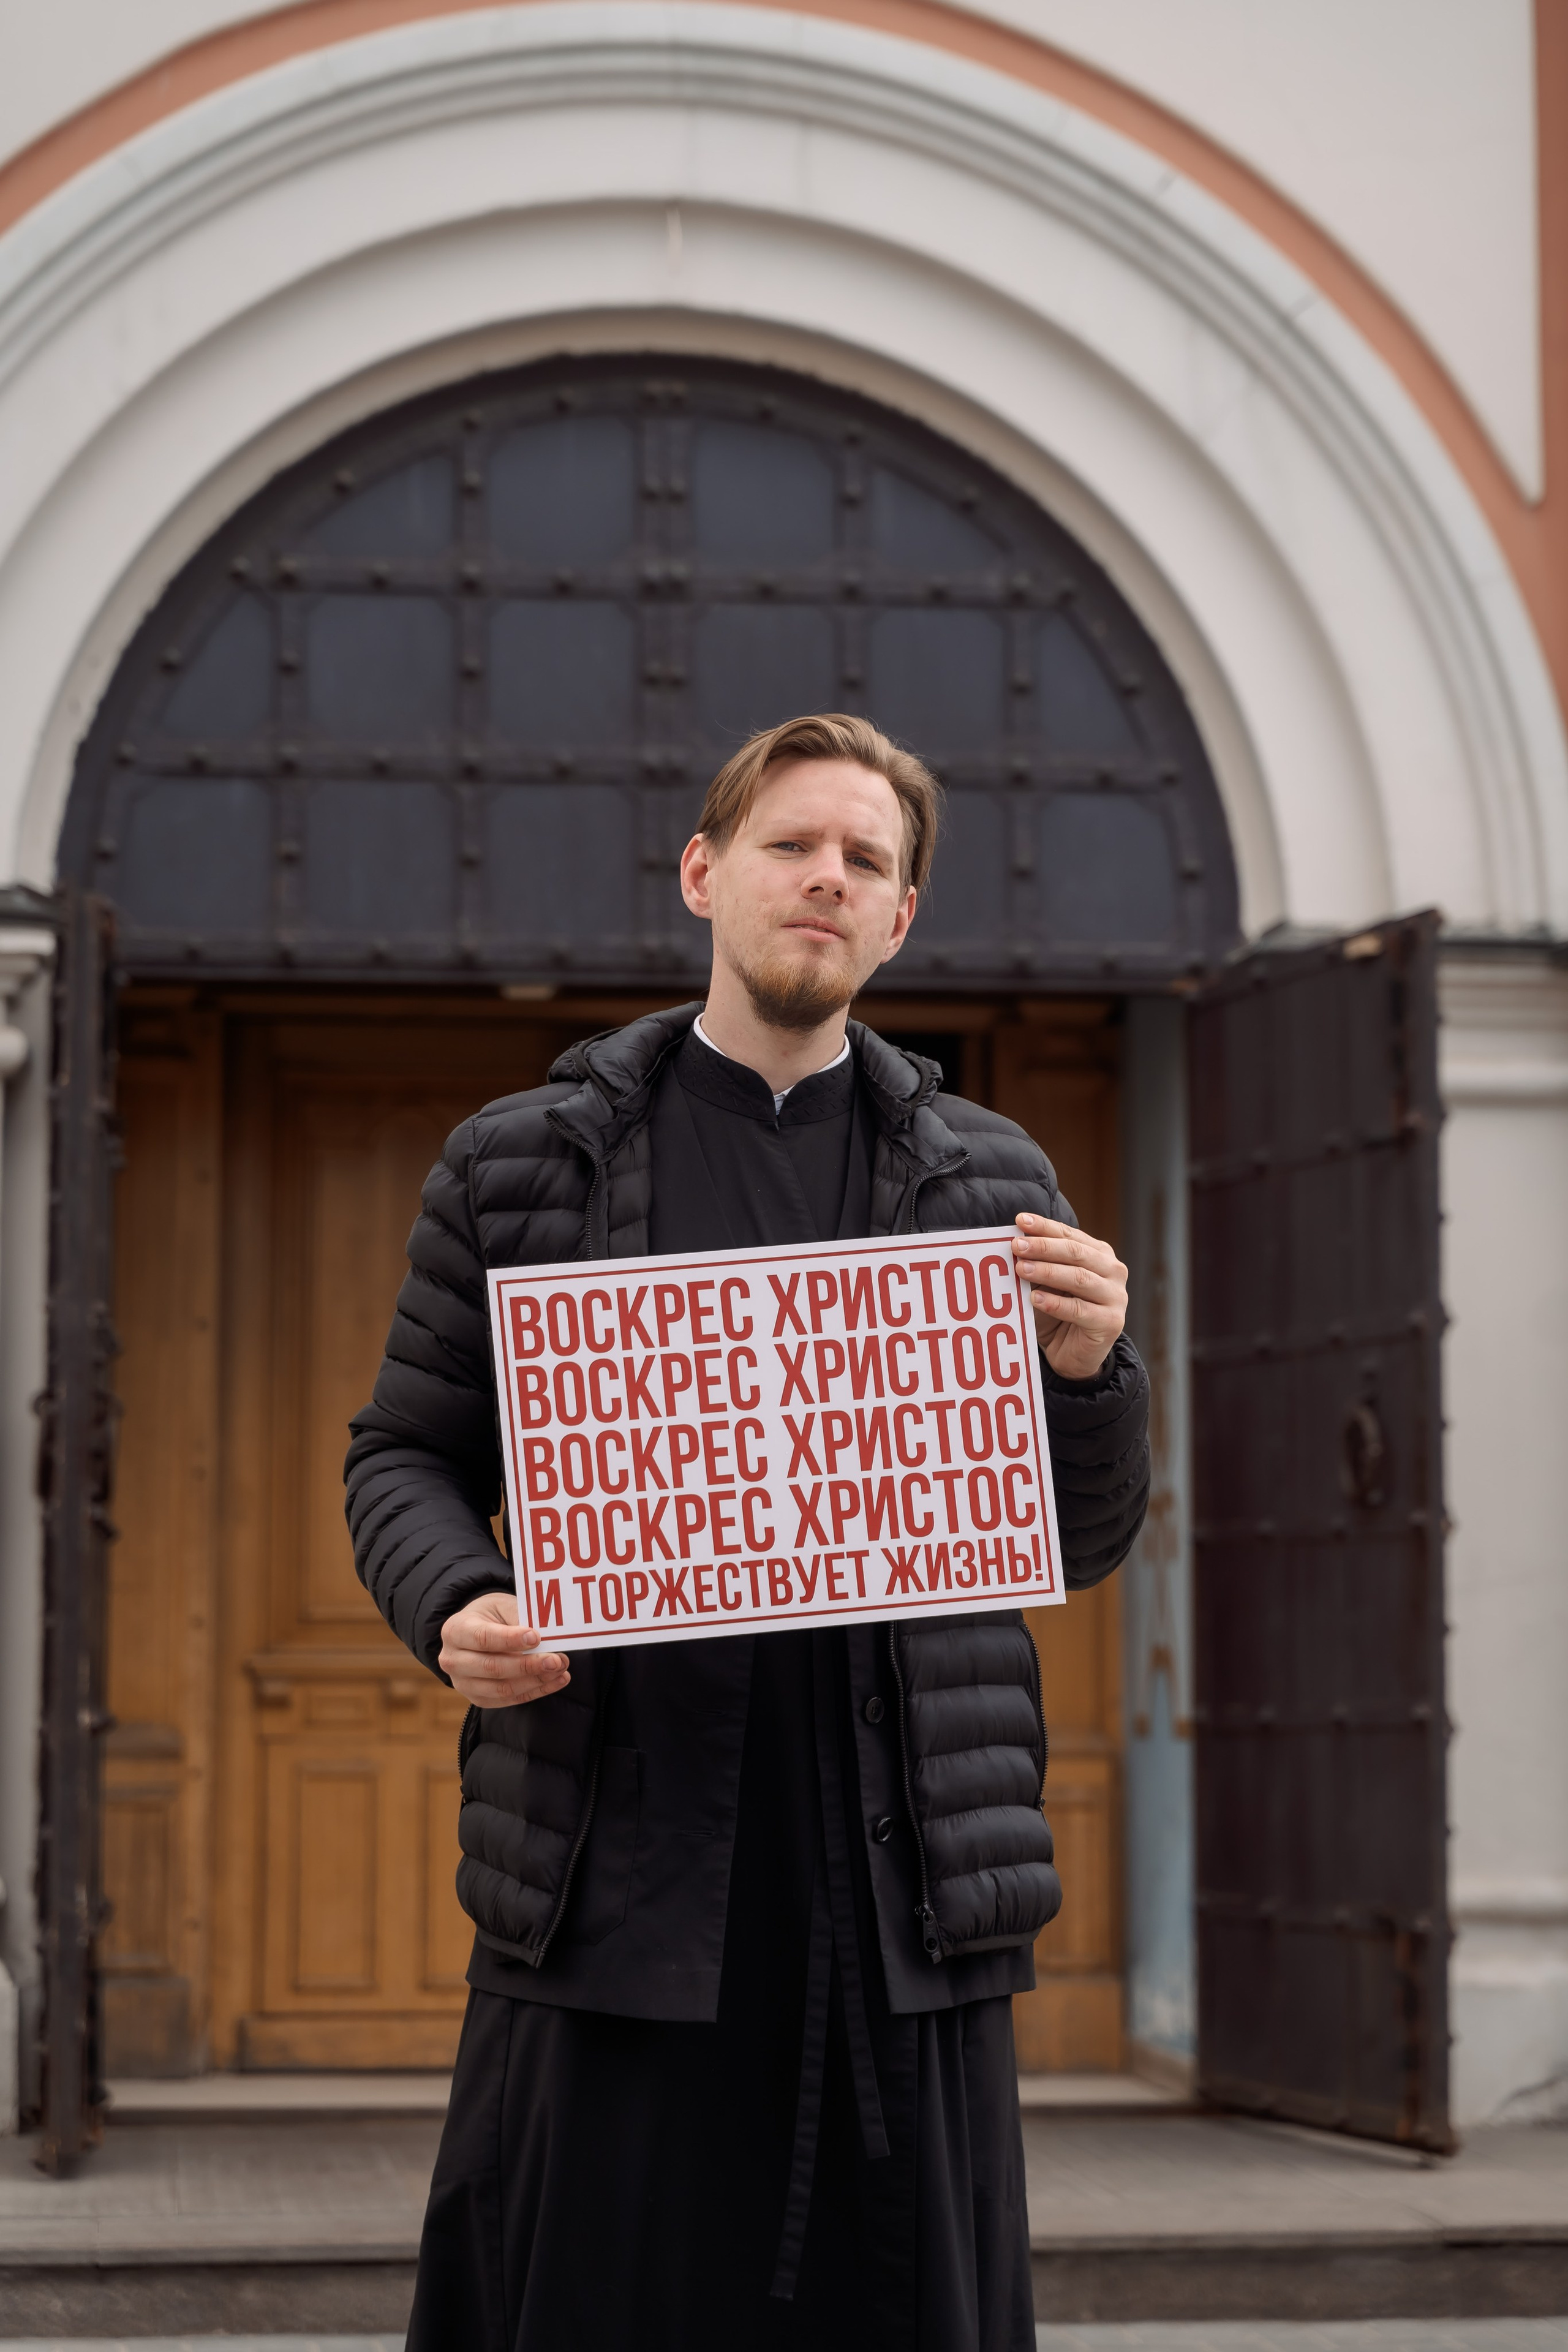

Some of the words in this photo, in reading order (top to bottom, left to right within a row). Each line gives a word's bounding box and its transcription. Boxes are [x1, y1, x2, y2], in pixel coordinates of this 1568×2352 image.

[510, 1278, 753, 1359] ВОСКРЕС
[768, 1256, 1012, 1336] ХРИСТОС
[516, 1347, 760, 1429] ВОСКРЕС
[775, 1324, 1020, 1406] ХРИСТОС
[524, 1418, 767, 1501] ВОСКРЕС
[782, 1395, 1028, 1477] ХРИСТОС
[530, 1488, 774, 1572] ВОСКРЕС
[790, 1464, 1035, 1547] ХРИСТОС
[536, 1579, 563, 1627] И
[573, 1550, 869, 1623] ТОРЖЕСТВУЕТ
[882, 1534, 1043, 1595] ЖИЗНЬ!
